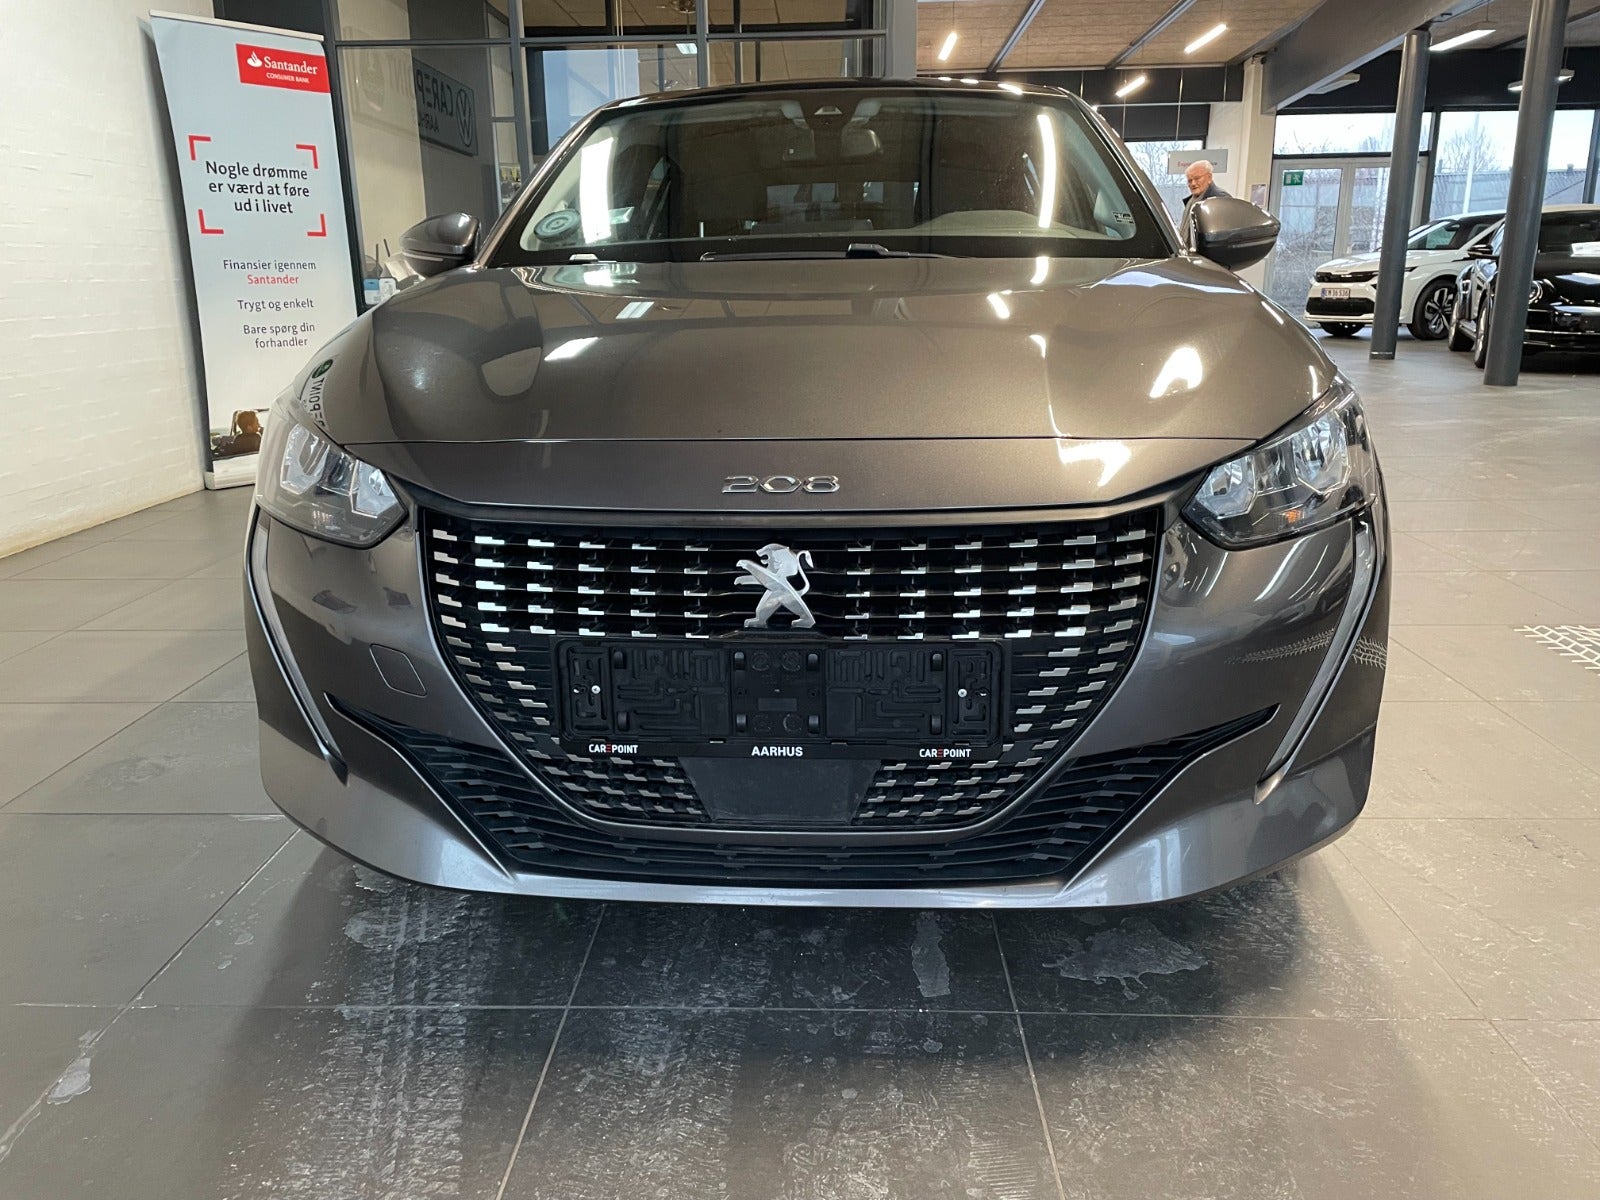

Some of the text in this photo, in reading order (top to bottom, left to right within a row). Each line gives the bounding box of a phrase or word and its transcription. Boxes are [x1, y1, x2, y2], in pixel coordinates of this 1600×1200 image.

[264, 56, 318, 75] Santander
[266, 72, 310, 84] CONSUMER BANK
[205, 160, 308, 180] Nogle drømme
[208, 181, 310, 197] er værd at føre
[234, 198, 294, 214] ud i livet
[223, 259, 317, 273] Finansier igennem
[247, 274, 299, 285] Santander
[237, 298, 315, 313] Trygt og enkelt
[243, 322, 316, 336] Bare spørg din
[255, 337, 309, 349] forhandler
[722, 475, 840, 493] 208
[751, 745, 804, 757] AARHUS
